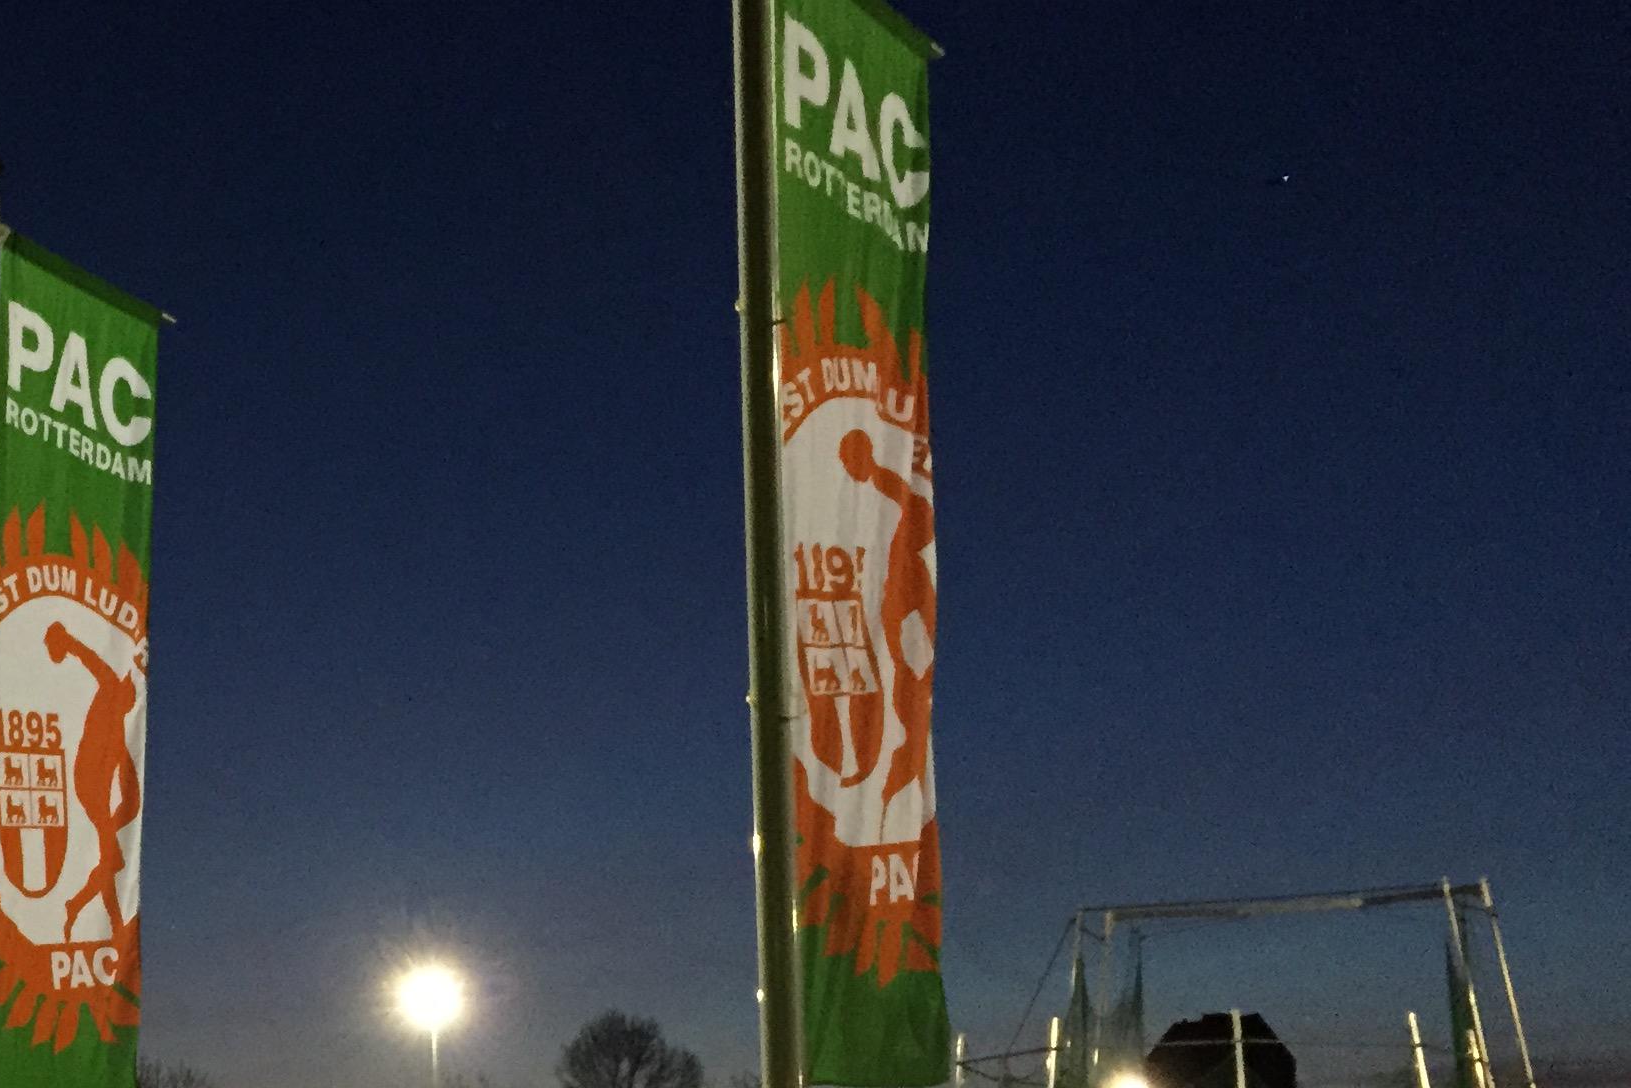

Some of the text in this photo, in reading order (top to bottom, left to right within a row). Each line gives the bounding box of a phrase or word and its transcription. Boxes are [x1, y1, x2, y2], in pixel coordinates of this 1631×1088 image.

[783, 10, 930, 208] PAC
[7, 300, 152, 447] PAC
[6, 396, 152, 485] ROTTERDAM
[26, 564, 77, 596] DUM
[51, 946, 119, 990] PAC
